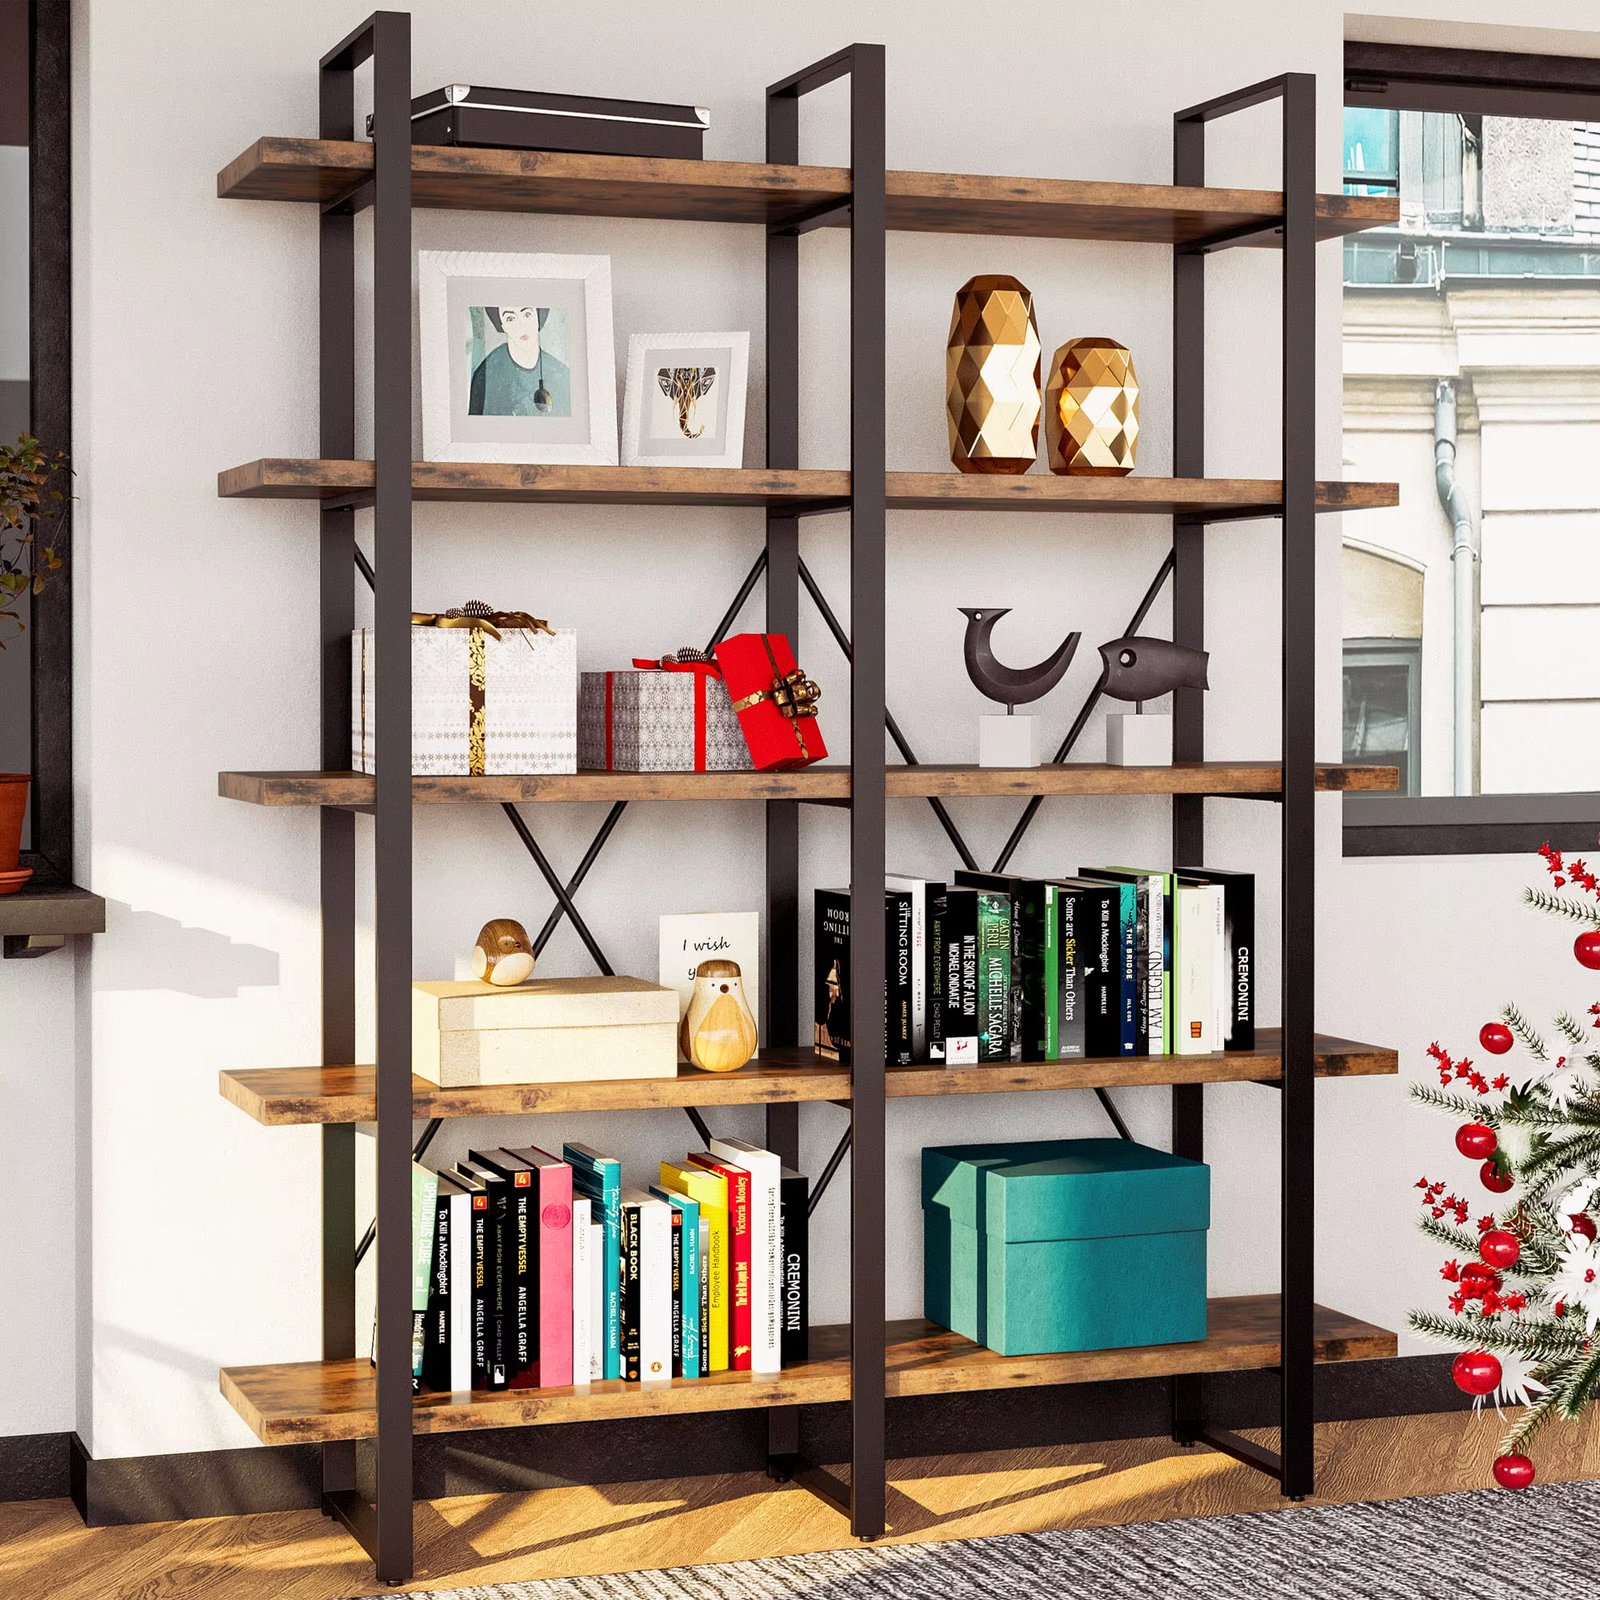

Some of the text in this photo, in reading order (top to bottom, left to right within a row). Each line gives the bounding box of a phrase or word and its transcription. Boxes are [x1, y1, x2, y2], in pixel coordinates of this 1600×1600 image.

[827, 908, 850, 922] ROOM
[1101, 910, 1109, 921] Kill
[1102, 900, 1109, 908] To
[683, 936, 731, 951] I wish
[823, 920, 850, 936] ITTING
[833, 936, 843, 944] THE
[898, 901, 908, 985] SITTING ROOM
[964, 935, 975, 943] IN
[987, 923, 999, 949] PERIL
[999, 918, 1010, 950] CAST IN
[933, 920, 941, 995] AWAY FROM EVERYWHERE
[964, 945, 975, 960] THE
[1065, 897, 1076, 1021] Some are Sicker Than Others
[1099, 929, 1109, 972] Mockingbird
[948, 943, 960, 1008] MICHAEL ONDAATJE
[964, 961, 975, 978] SKIN
[964, 979, 975, 990] OF
[1149, 951, 1162, 1000] LEGEND
[1238, 947, 1249, 1021] CREMONINI
[933, 1003, 941, 1039] CHAD PELLEY
[964, 998, 975, 1015] LION
[988, 957, 1002, 1054] MICHELLE SAGARA
[1149, 1007, 1162, 1028] AM
[439, 1209, 448, 1220] To
[735, 1176, 748, 1235] Victoria Mosley
[439, 1221, 448, 1234] Kill
[518, 1197, 527, 1275] THE EMPTY VESSEL
[418, 1240, 432, 1264] CUBE
[630, 1213, 638, 1281] BLACK BOOK
[436, 1243, 448, 1295] Mockingbird
[711, 1229, 721, 1308] Employee Handbook
[787, 1253, 800, 1331] CREMONINI
[414, 1313, 425, 1338] Hendrik
[476, 1299, 484, 1368] ANGELLA GRAFF
[518, 1286, 527, 1363] ANGELLA GRAFF
